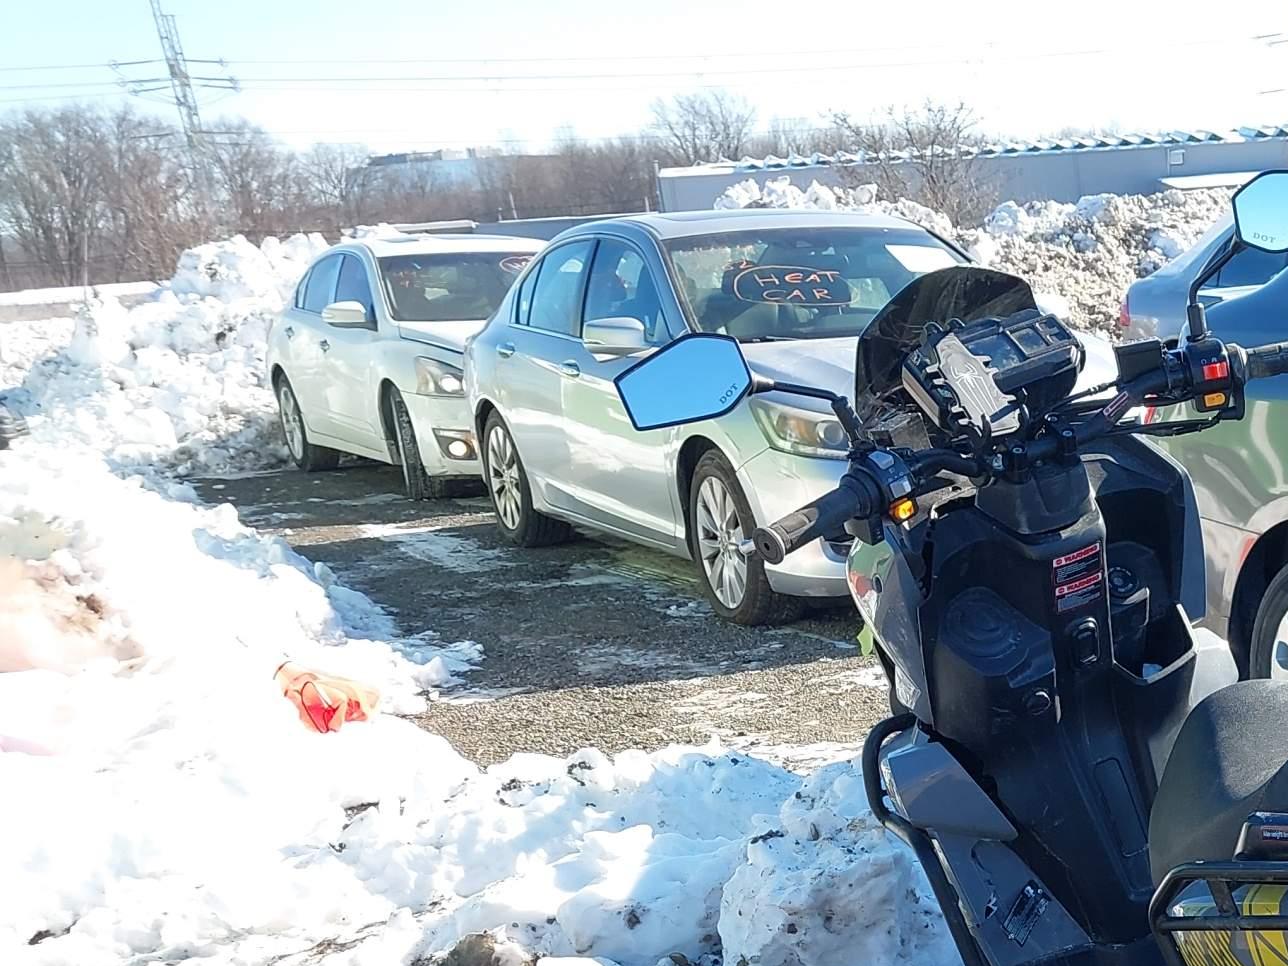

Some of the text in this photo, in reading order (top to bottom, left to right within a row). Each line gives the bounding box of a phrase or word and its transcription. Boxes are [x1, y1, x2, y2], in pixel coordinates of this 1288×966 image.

[1253, 232, 1277, 243] DOT
[754, 271, 840, 287] HEAT
[763, 289, 832, 300] CAR
[719, 383, 738, 404] DOT
